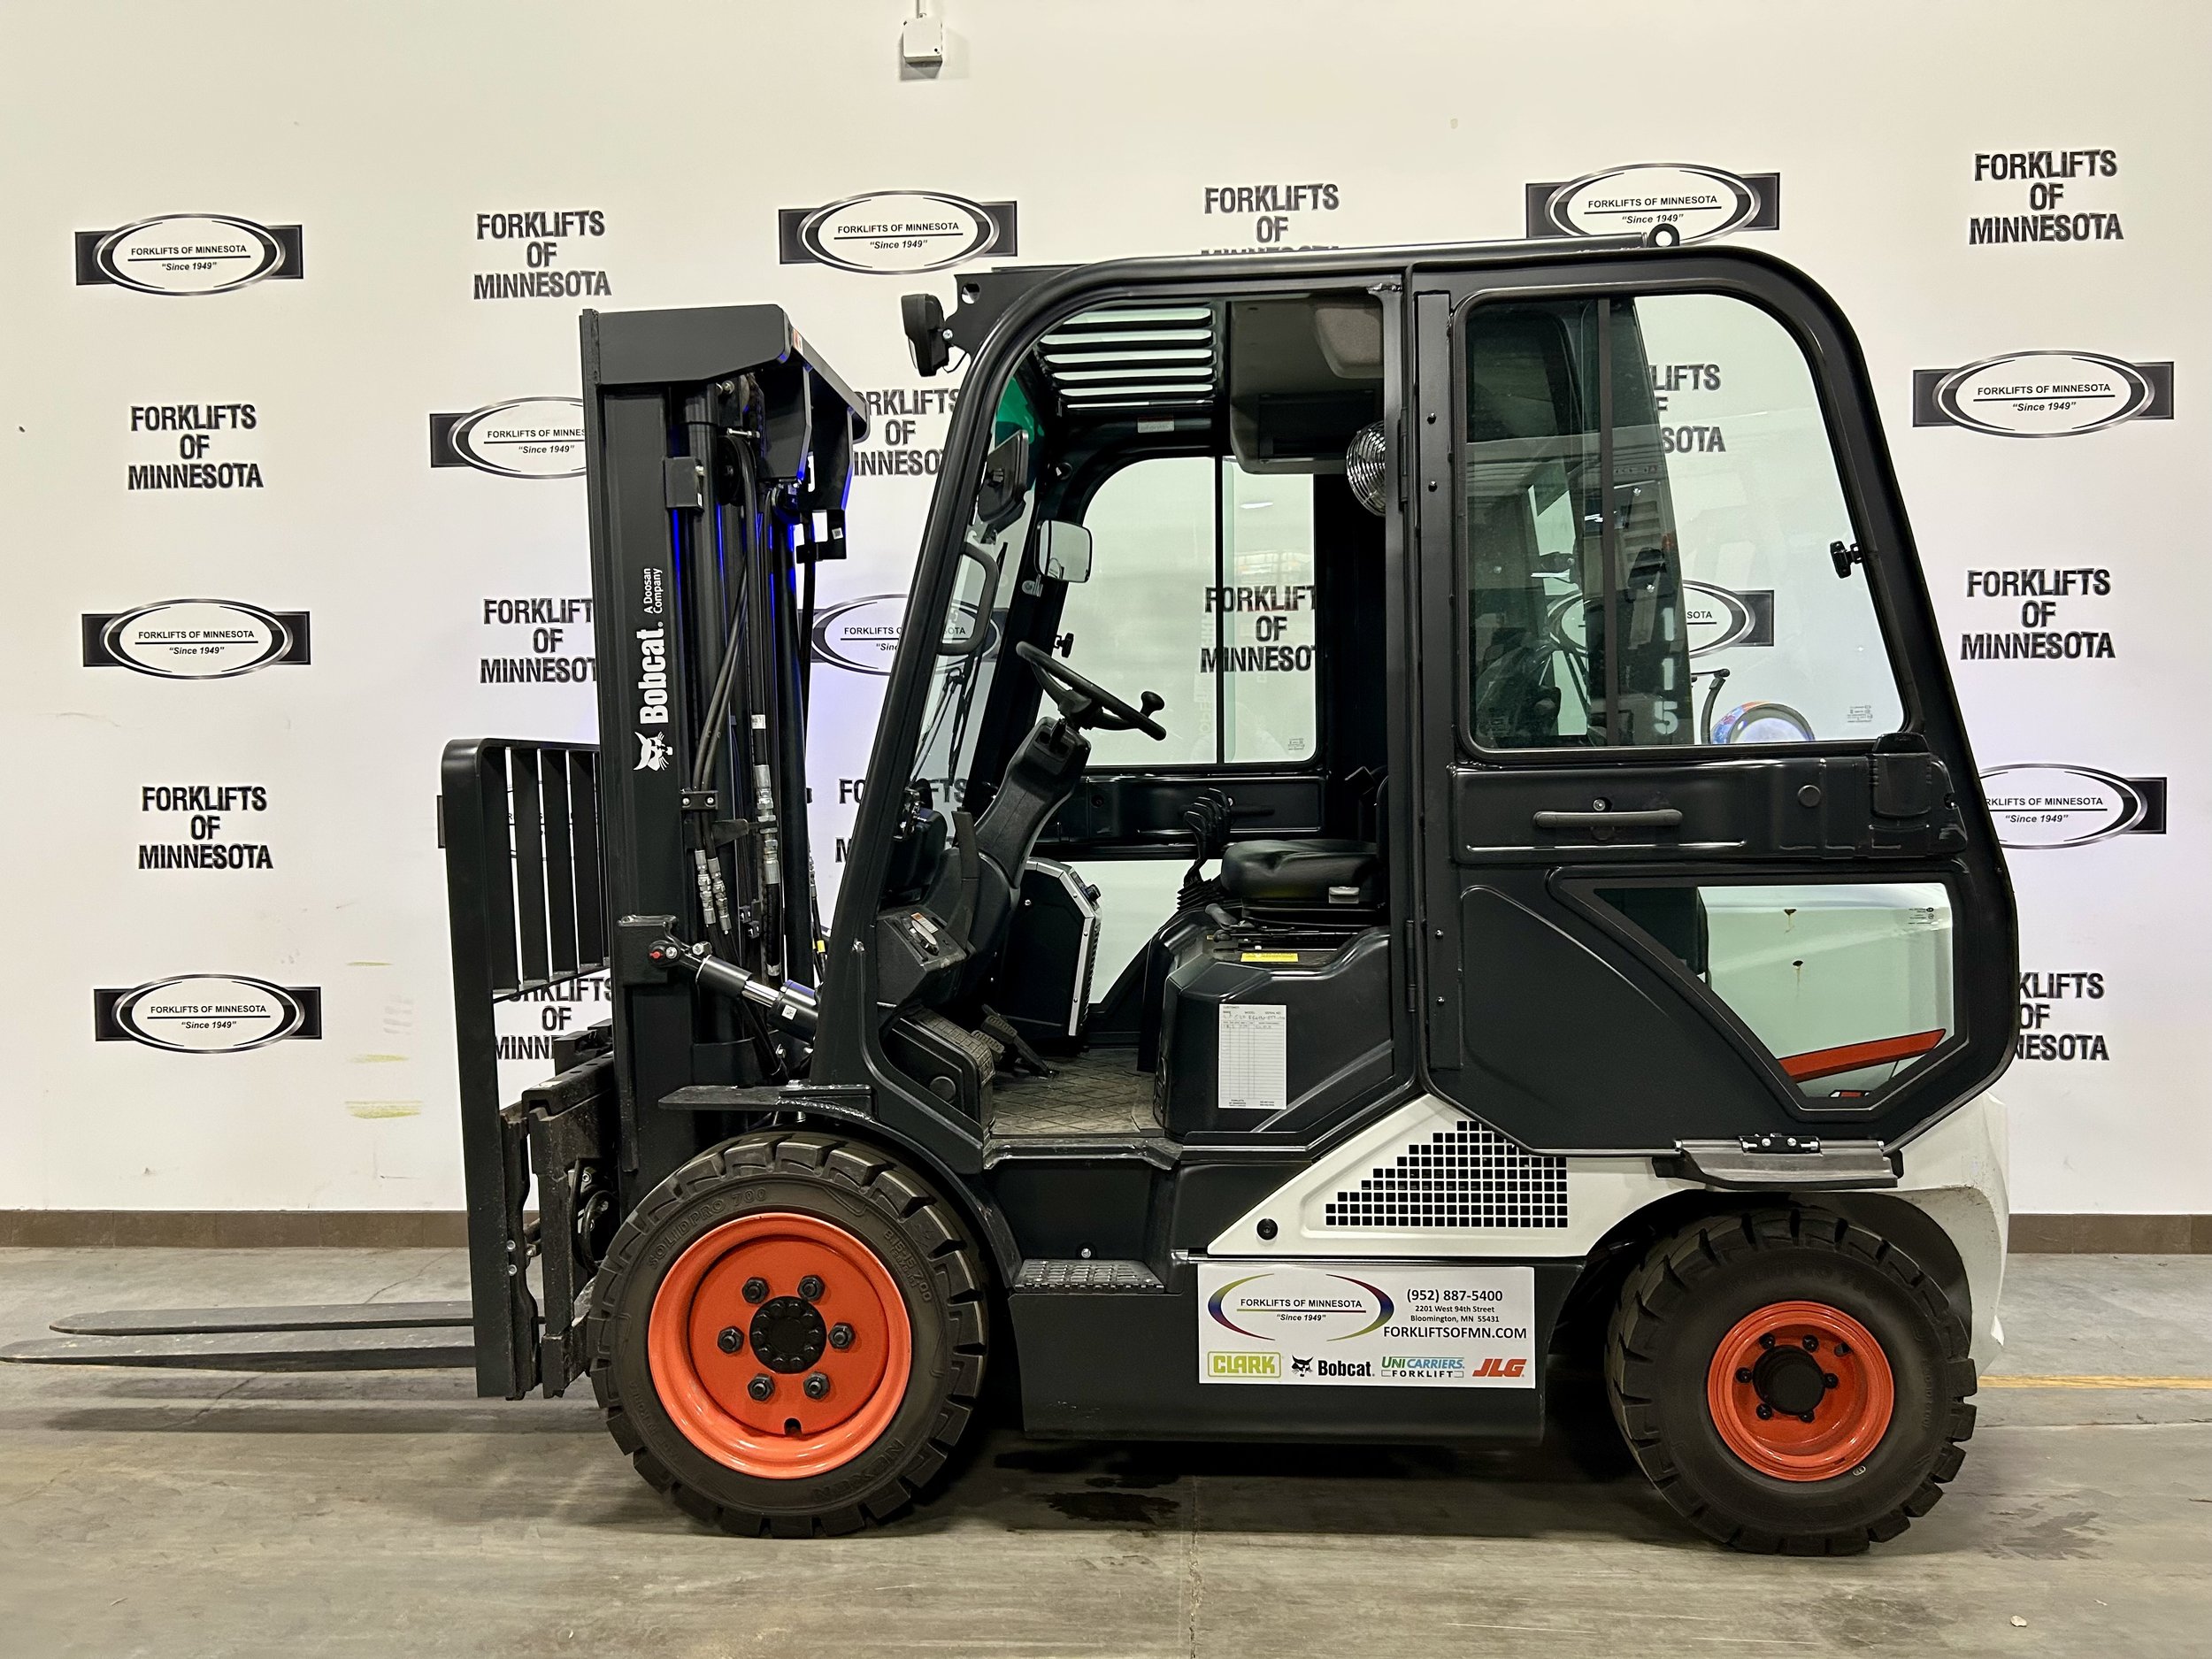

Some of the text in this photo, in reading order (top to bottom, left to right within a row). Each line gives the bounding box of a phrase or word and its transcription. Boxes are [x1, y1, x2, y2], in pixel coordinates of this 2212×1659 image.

[1975, 150, 2117, 181] FORKLIFTS
[1205, 184, 1339, 214] FORKLIFTS
[1587, 195, 1717, 209] FORKLIFTS OF MINNESOTA
[2030, 182, 2063, 211] OF
[477, 211, 604, 238] FORKLIFTS
[837, 222, 959, 234] FORKLIFTS OF MINNESOTA
[1256, 216, 1288, 242] OF
[1970, 213, 2124, 244] MINNESOTA
[131, 244, 247, 256] FORKLIFTS OF MINNESOTA
[527, 242, 557, 268] OF
[474, 271, 611, 299] MINNESOTA
[1649, 364, 1720, 391] LIFTS
[1978, 383, 2112, 396] FORKLIFTS OF MINNESOTA
[131, 403, 257, 431] FORKLIFTS
[487, 429, 537, 439] FORKLIFTS
[885, 419, 916, 446] OF
[180, 434, 210, 459] OF
[853, 449, 944, 476] INNESO
[128, 463, 264, 489] MINNESOTA
[643, 568, 654, 614] A Doosan
[653, 568, 663, 614] Company
[1967, 568, 2110, 597] FORKLIFTS
[484, 598, 591, 624] FORKLIFT
[2022, 600, 2056, 627] OF
[138, 631, 187, 640] FORKLIFTS
[203, 630, 255, 639] MINNESOTA
[534, 627, 563, 653] OF
[844, 626, 895, 635] FORKLIFTS
[1256, 616, 1287, 641] OF
[1961, 632, 2116, 660] MINNESOTA
[480, 657, 595, 683] MINNESOT
[636, 628, 669, 724] Bobcat
[142, 786, 266, 811] FORKLIFTS
[1985, 797, 2103, 806] RKLIFTS OF MINNESOTA
[191, 815, 220, 840] OF
[139, 844, 273, 869] MINNESOTA
[2019, 972, 2105, 999] KLIFTS
[150, 1005, 199, 1014] FORKLIFTS
[215, 1004, 267, 1013] MINNESOTA
[541, 1004, 572, 1031] OF
[649, 1198, 726, 1270] SOLIDPRO
[1240, 1298, 1363, 1309] FORKLIFTS OF MINNESOTA
[1407, 1288, 1503, 1303] (952) 887-5400
[1383, 1325, 1527, 1339] FORKLIFTSOFMN.COM
[1410, 1314, 1459, 1324] Bloomington,
[1213, 1355, 1275, 1373] CLARK
[1317, 1360, 1371, 1377] Bobcat
[1471, 1358, 1527, 1378] JLG
